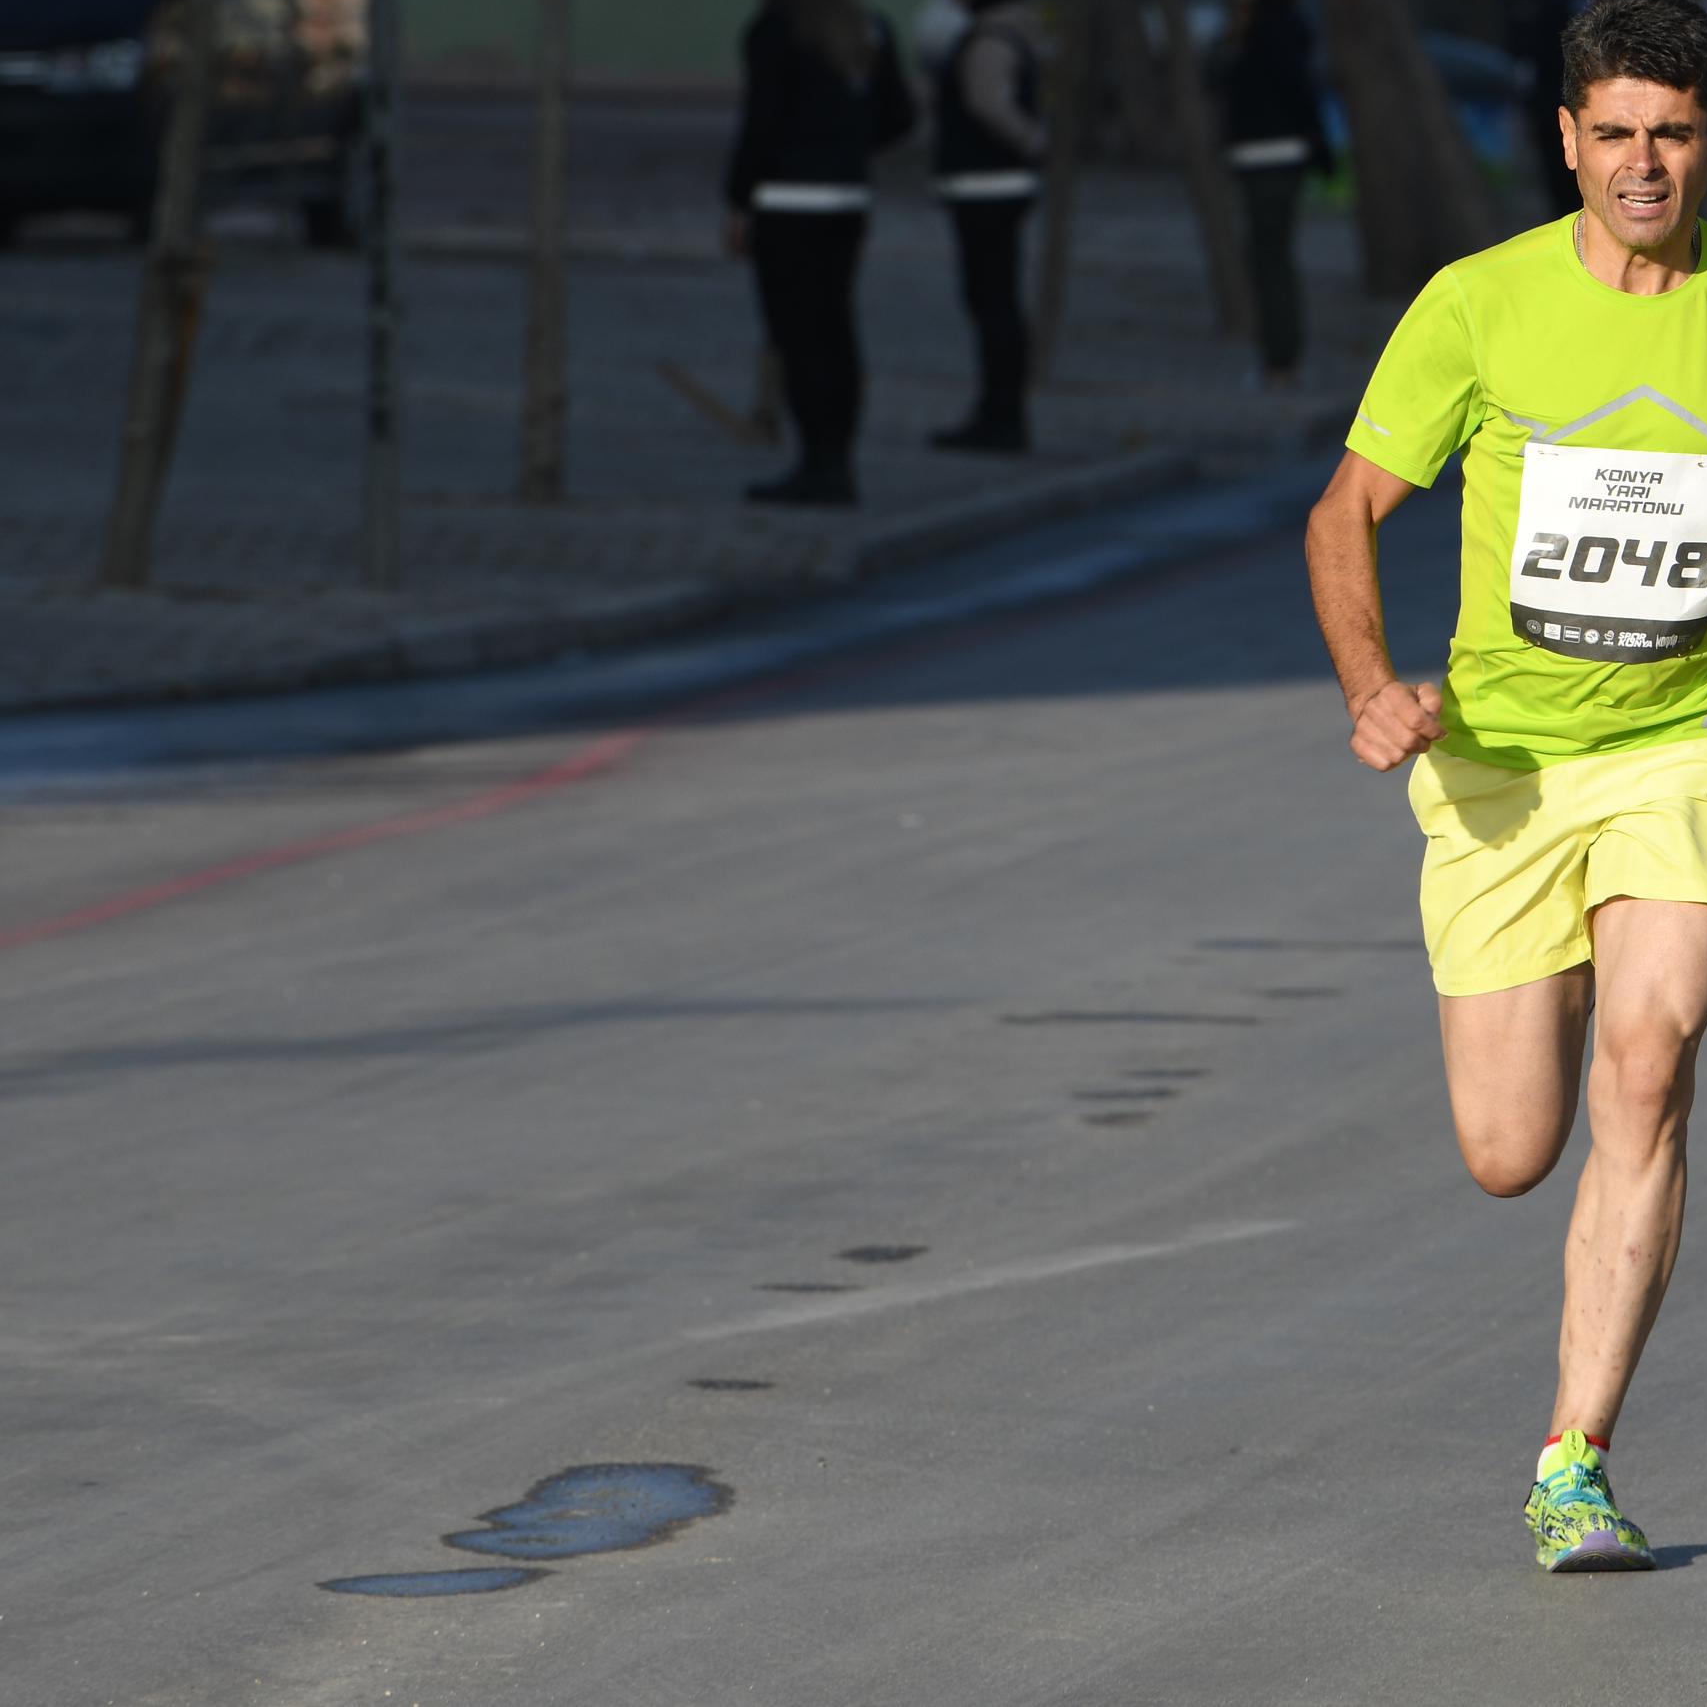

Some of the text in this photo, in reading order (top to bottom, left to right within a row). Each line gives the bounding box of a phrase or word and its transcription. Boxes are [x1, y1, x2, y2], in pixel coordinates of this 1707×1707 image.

[1594, 468, 1664, 485] KONYA
[1605, 484, 1651, 499] YARI
[1568, 496, 1684, 516] MARATONU
